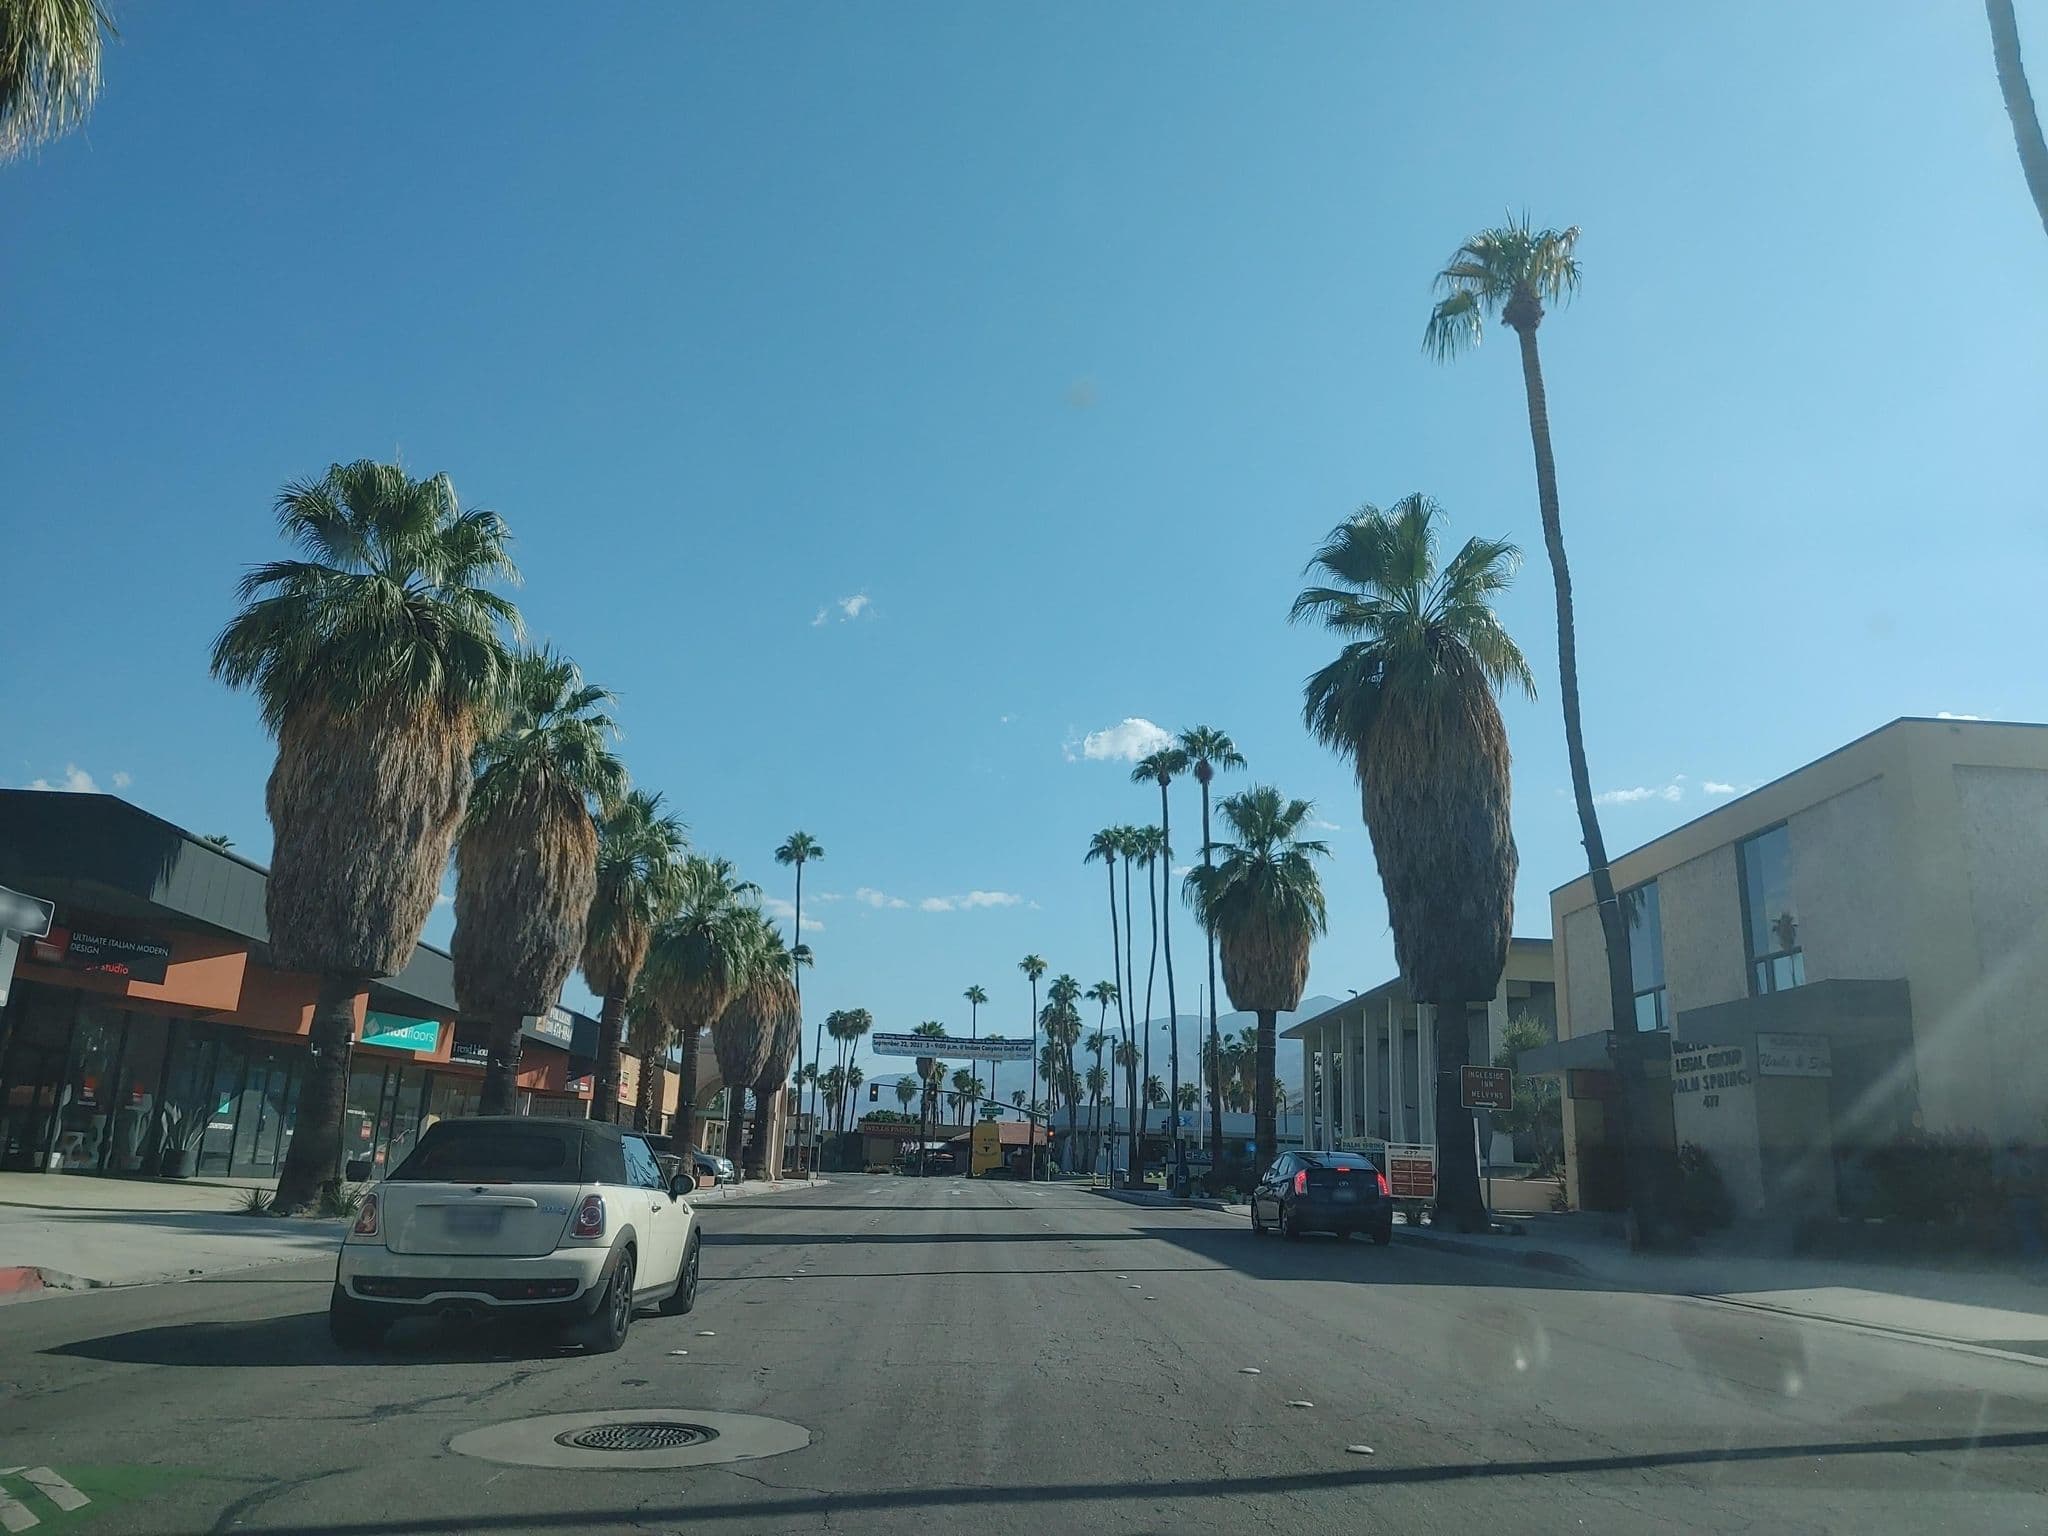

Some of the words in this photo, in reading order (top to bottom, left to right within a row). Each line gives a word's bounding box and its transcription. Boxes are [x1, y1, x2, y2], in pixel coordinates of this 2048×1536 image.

[70, 943, 99, 955] DESIGN
[73, 932, 107, 945] ULTIMATE
[109, 939, 136, 950] ITALIAN
[136, 945, 169, 957] MODERN
[873, 1039, 900, 1047] September
[473, 1043, 488, 1057] Hou
[1675, 1055, 1706, 1074] LEGAL
[1706, 1050, 1743, 1069] GROUP
[1467, 1071, 1504, 1080] INGLESIDE
[1481, 1080, 1494, 1088] INN
[1672, 1076, 1700, 1094] PALM
[1471, 1089, 1504, 1099] MELVYNS
[1703, 1095, 1719, 1108] 477
[865, 1125, 889, 1133] WELLS
[890, 1126, 914, 1134] FARGO
[1362, 1142, 1385, 1150] SPRING
[1185, 1151, 1213, 1160] CHAS
